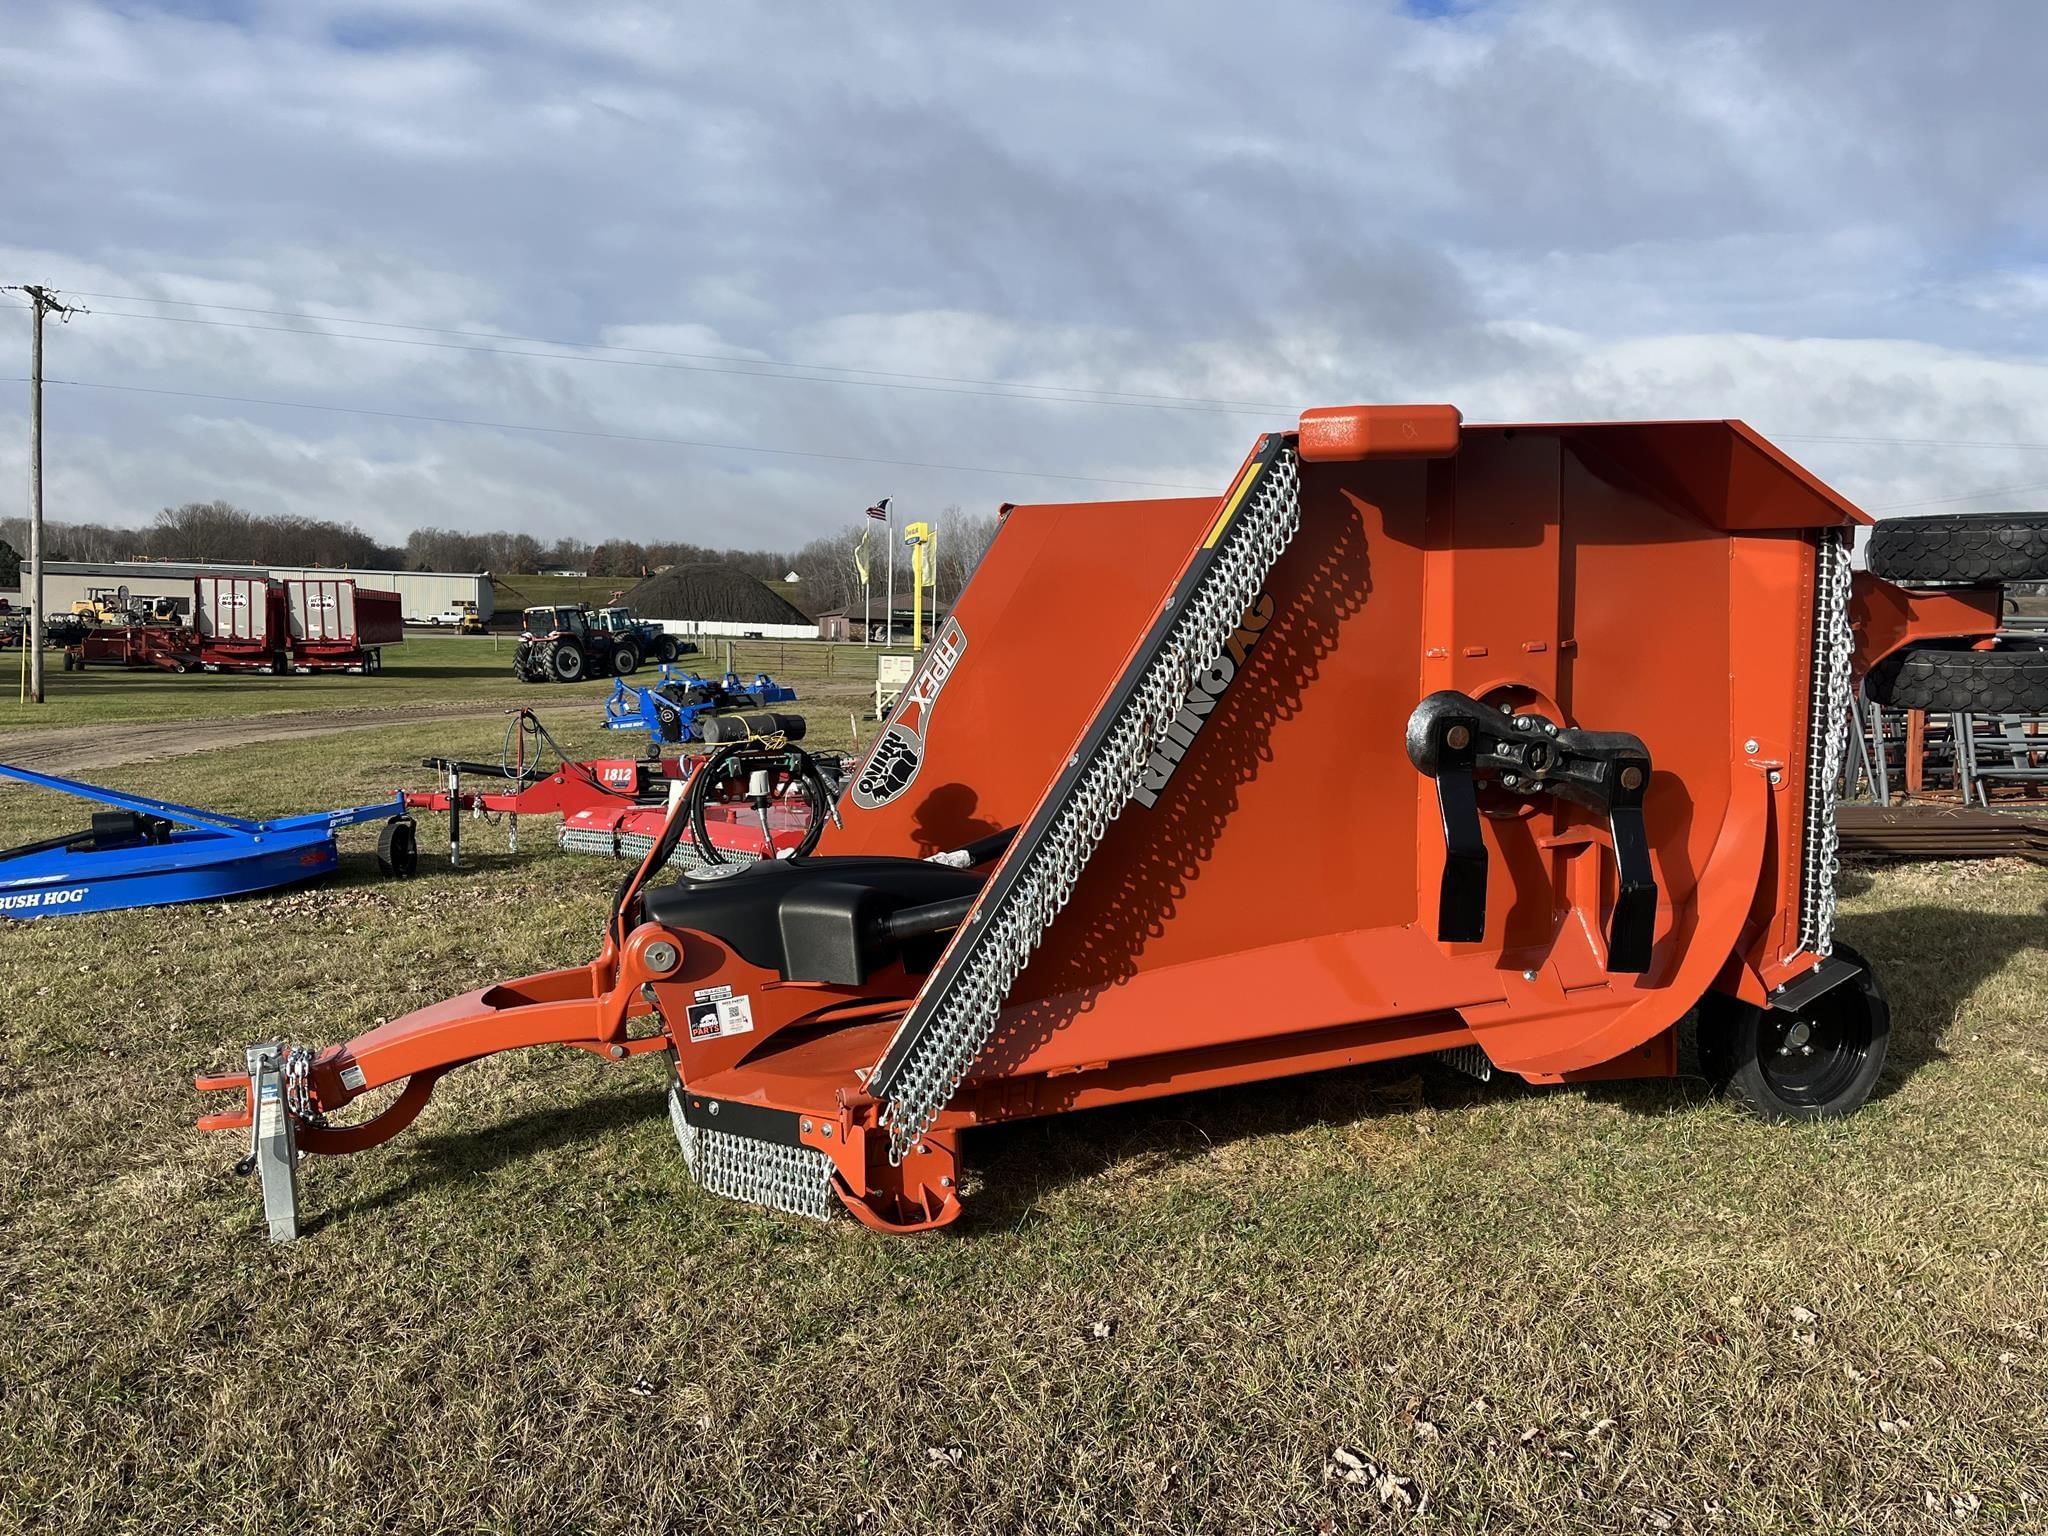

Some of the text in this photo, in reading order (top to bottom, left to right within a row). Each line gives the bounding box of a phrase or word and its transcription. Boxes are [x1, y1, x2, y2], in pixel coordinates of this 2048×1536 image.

[908, 637, 959, 714] APEX
[603, 768, 632, 781] 1812
[858, 730, 904, 794] RHINO
[693, 1024, 720, 1036] PARTS
